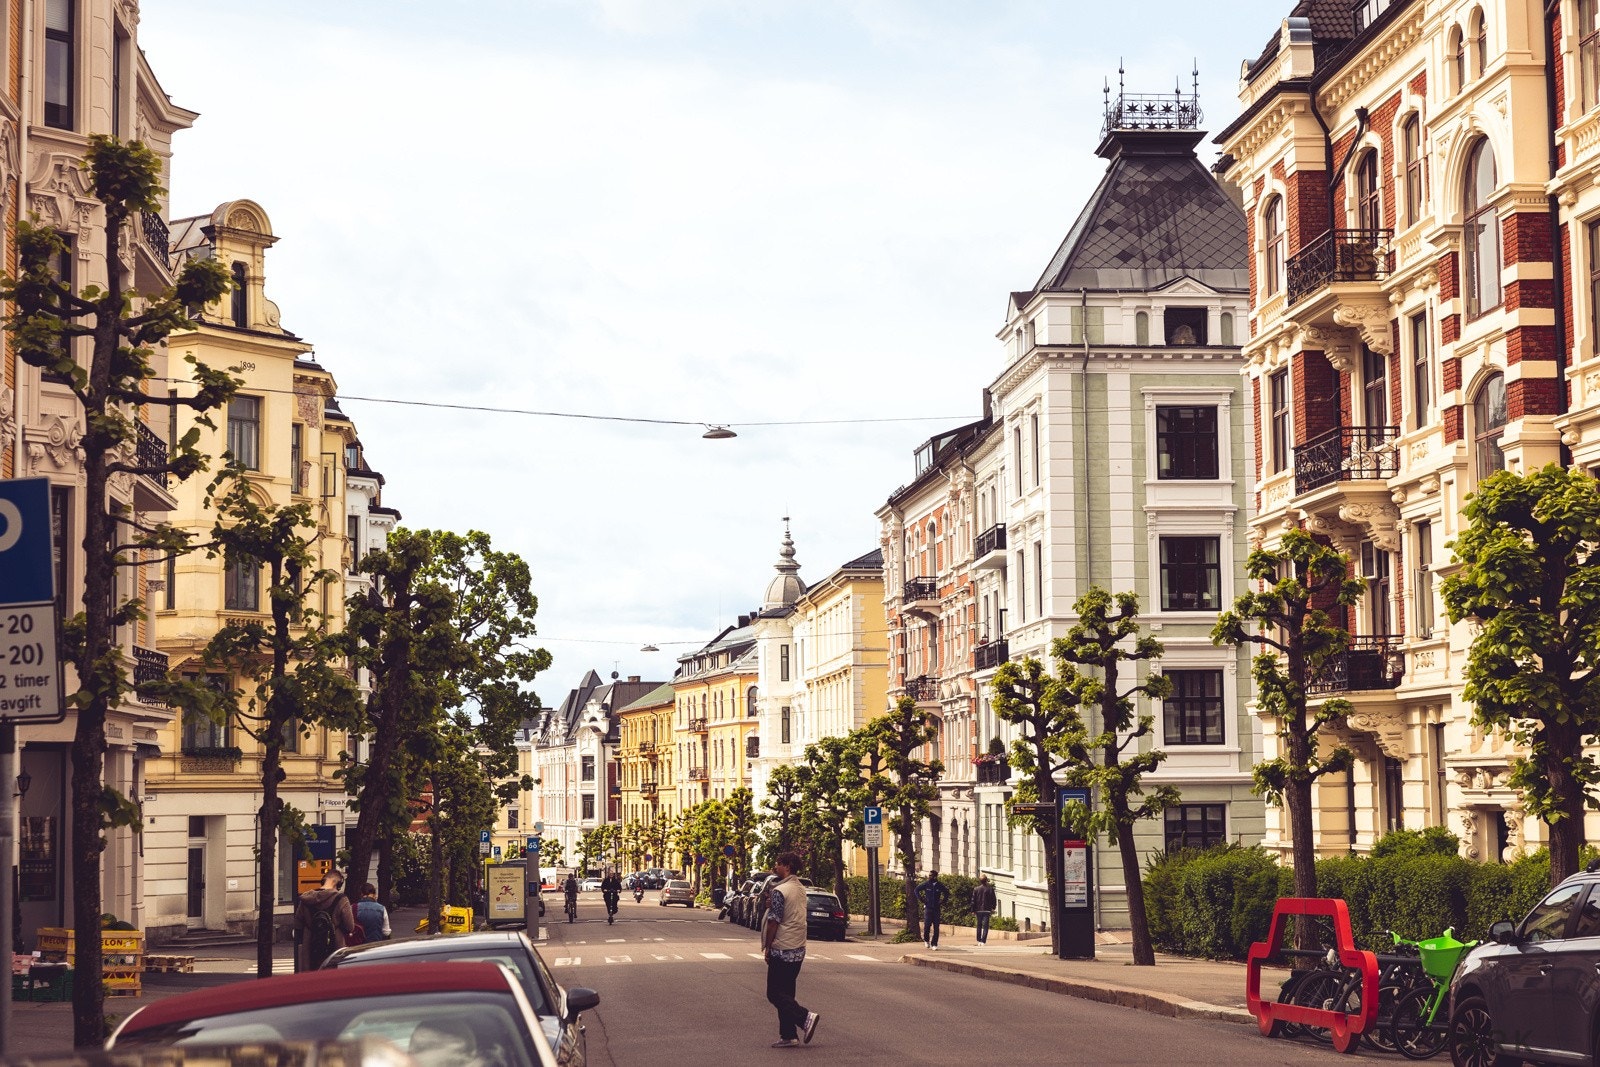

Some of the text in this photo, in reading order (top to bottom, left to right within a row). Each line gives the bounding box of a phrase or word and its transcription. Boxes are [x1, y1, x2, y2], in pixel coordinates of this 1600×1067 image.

[240, 361, 256, 371] 1899
[14, 674, 50, 687] timer
[868, 809, 878, 822] P
[44, 937, 65, 945] MELON
